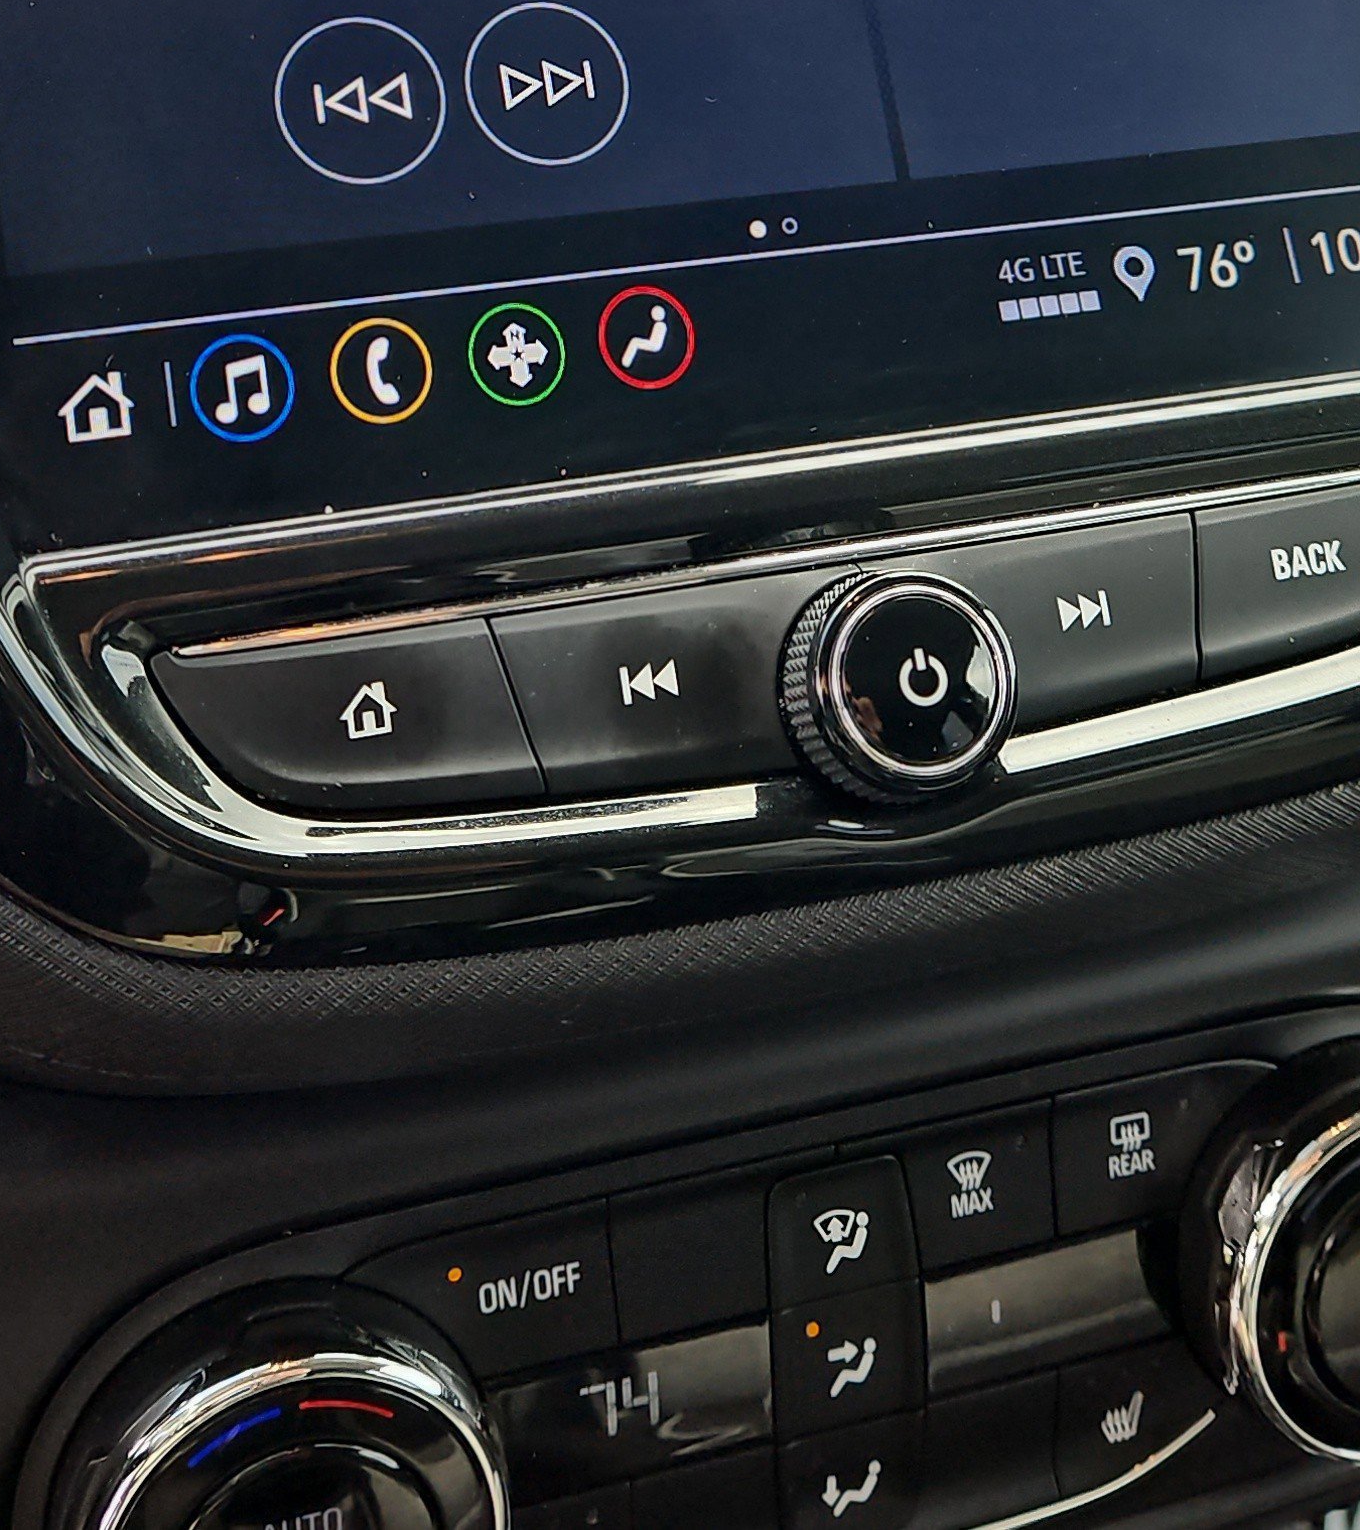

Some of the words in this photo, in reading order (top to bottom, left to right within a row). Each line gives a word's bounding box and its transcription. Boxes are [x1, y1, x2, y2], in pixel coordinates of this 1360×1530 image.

[998, 257, 1035, 284] 4G
[1042, 251, 1087, 279] LTE
[1270, 539, 1346, 581] BACK
[1107, 1149, 1156, 1179] REAR
[951, 1188, 993, 1218] MAX
[478, 1261, 581, 1315] ON/OFF
[580, 1371, 660, 1437] 74
